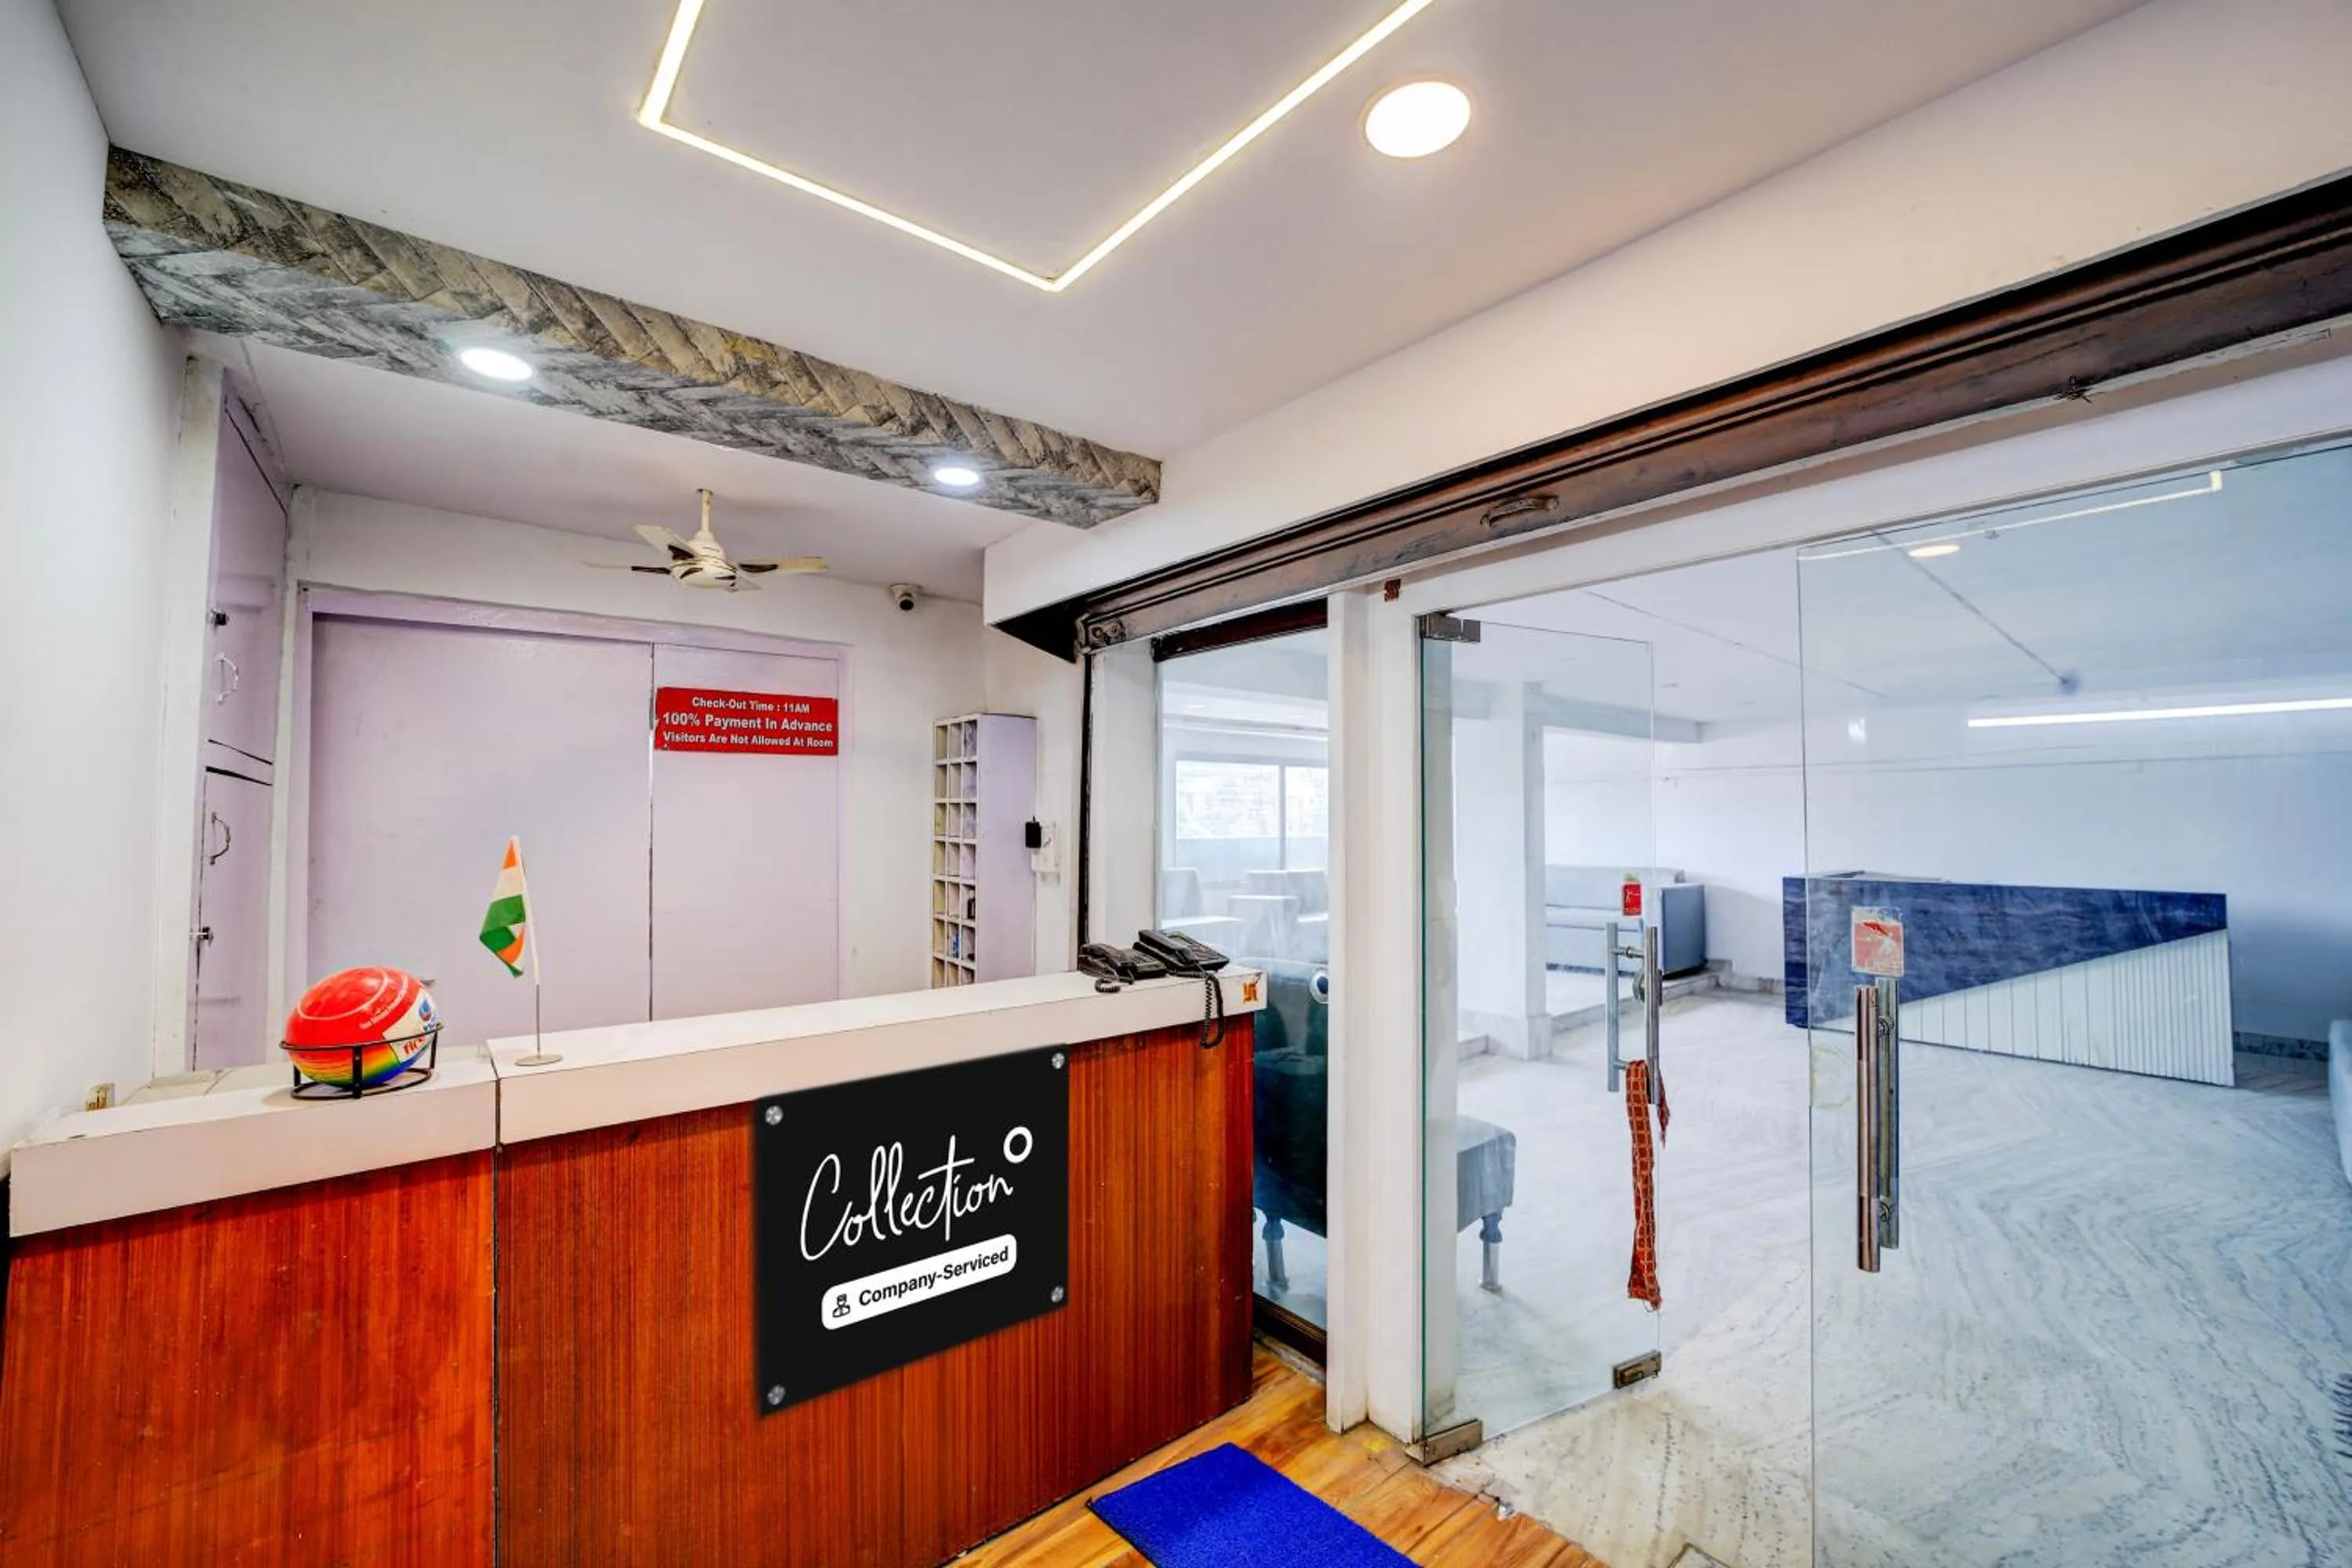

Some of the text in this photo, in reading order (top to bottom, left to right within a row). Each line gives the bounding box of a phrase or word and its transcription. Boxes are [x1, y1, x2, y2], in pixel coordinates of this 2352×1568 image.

[691, 696, 746, 710] Check-Out
[749, 699, 775, 712] Time
[783, 702, 810, 713] 11AM
[662, 711, 833, 732] 100% Payment In Advance
[662, 731, 833, 748] Visitors Are Not Allowed At Room
[800, 1134, 1014, 1261] Collection
[858, 1245, 1009, 1307] Company-Serviced
